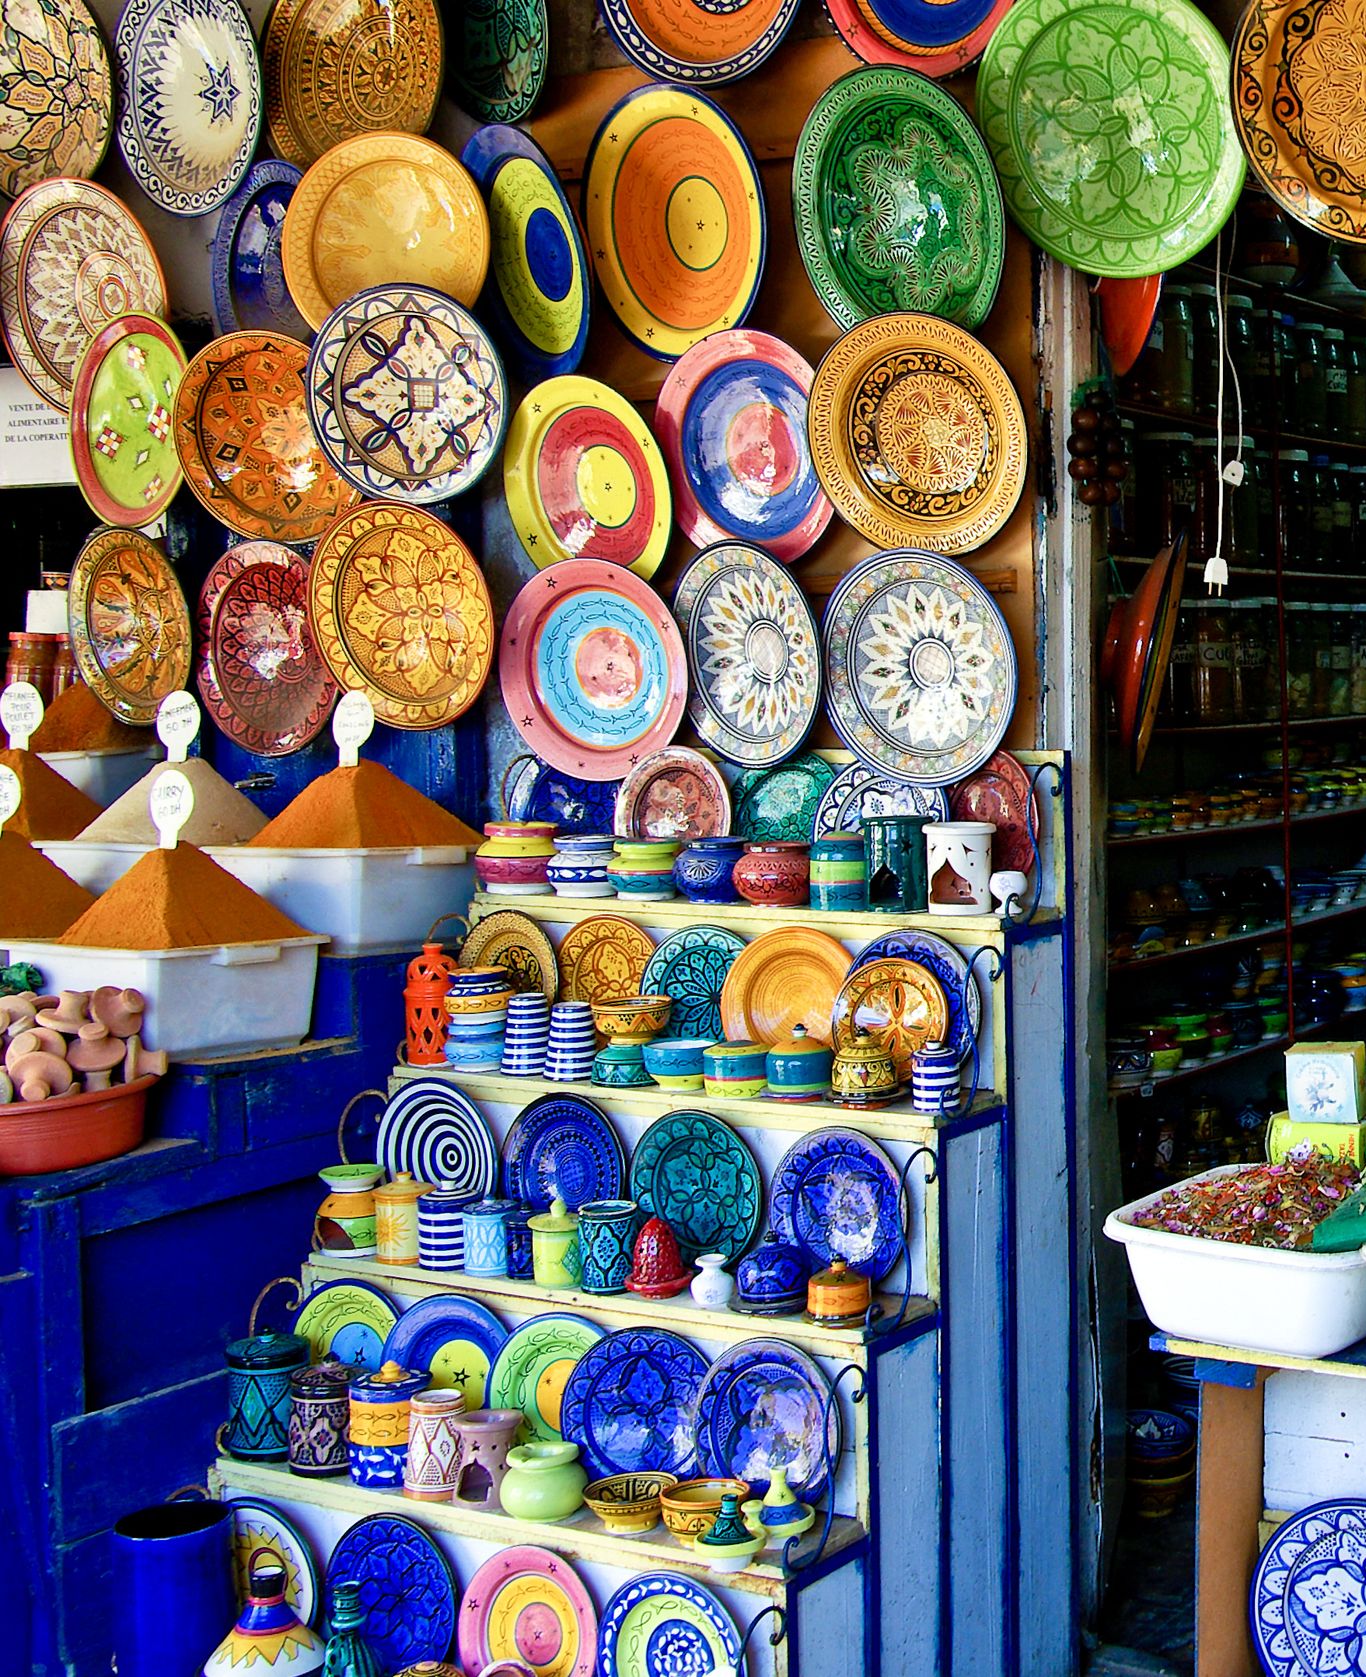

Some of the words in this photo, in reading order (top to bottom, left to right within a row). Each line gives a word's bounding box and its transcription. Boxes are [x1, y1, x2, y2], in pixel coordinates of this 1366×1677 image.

[8, 404, 33, 412] VENTE
[35, 403, 45, 411] DE
[8, 418, 60, 427] ALIMENTAIRE
[17, 434, 28, 442] LA
